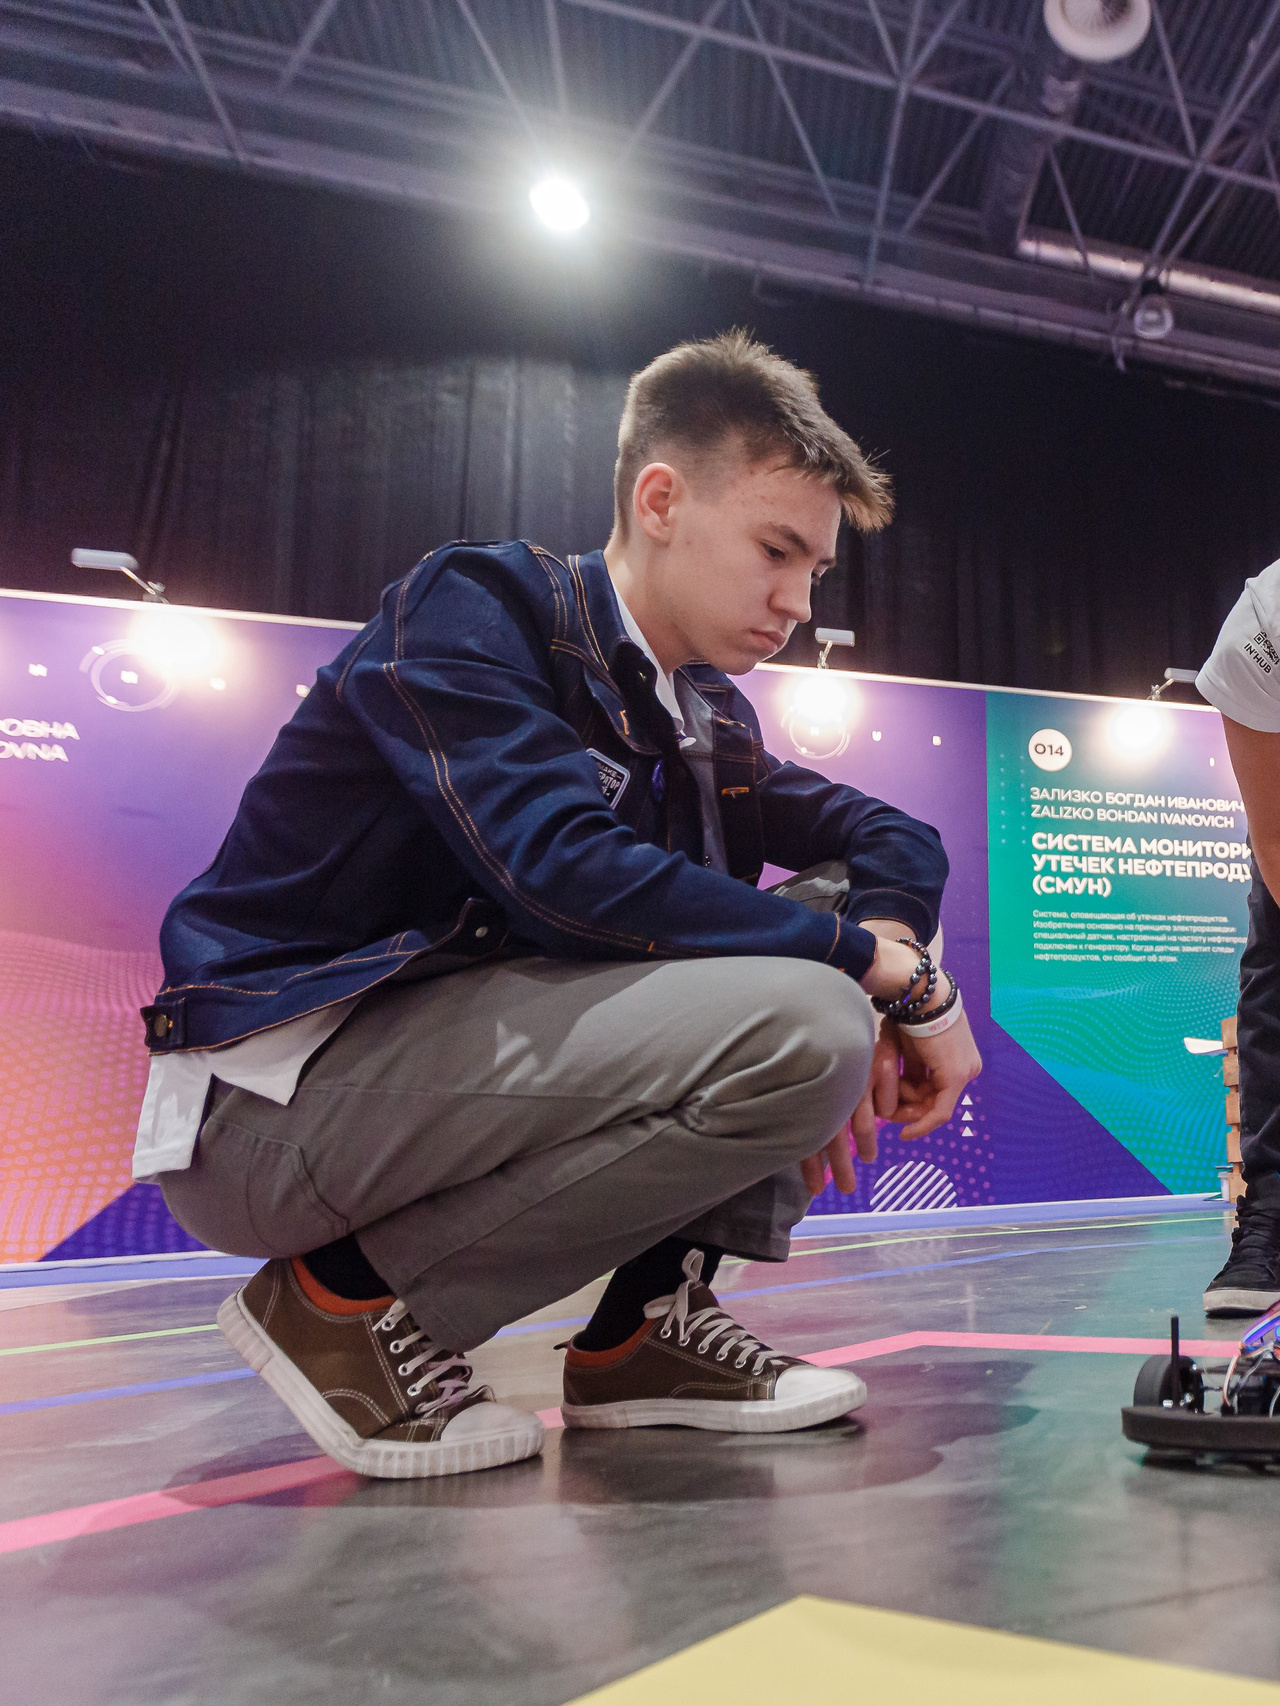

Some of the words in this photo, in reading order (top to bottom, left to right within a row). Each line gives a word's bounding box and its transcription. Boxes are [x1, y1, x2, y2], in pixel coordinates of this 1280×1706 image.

[1244, 642, 1272, 674] IN'HUB
[0, 717, 80, 740] ОВНА
[1030, 786, 1103, 804] ЗАЛИЗКО
[1105, 791, 1165, 809] БОГДАН
[1167, 795, 1245, 813] ИВАНОВИЧ
[1030, 804, 1094, 820] ZALIZKO
[1096, 808, 1158, 824] BOHDAN
[1160, 812, 1235, 829] IVANOVICH
[1031, 831, 1138, 854] СИСТЕМА
[1031, 853, 1116, 875] УТЕЧЕК
[1032, 874, 1112, 898] (СМУН)
